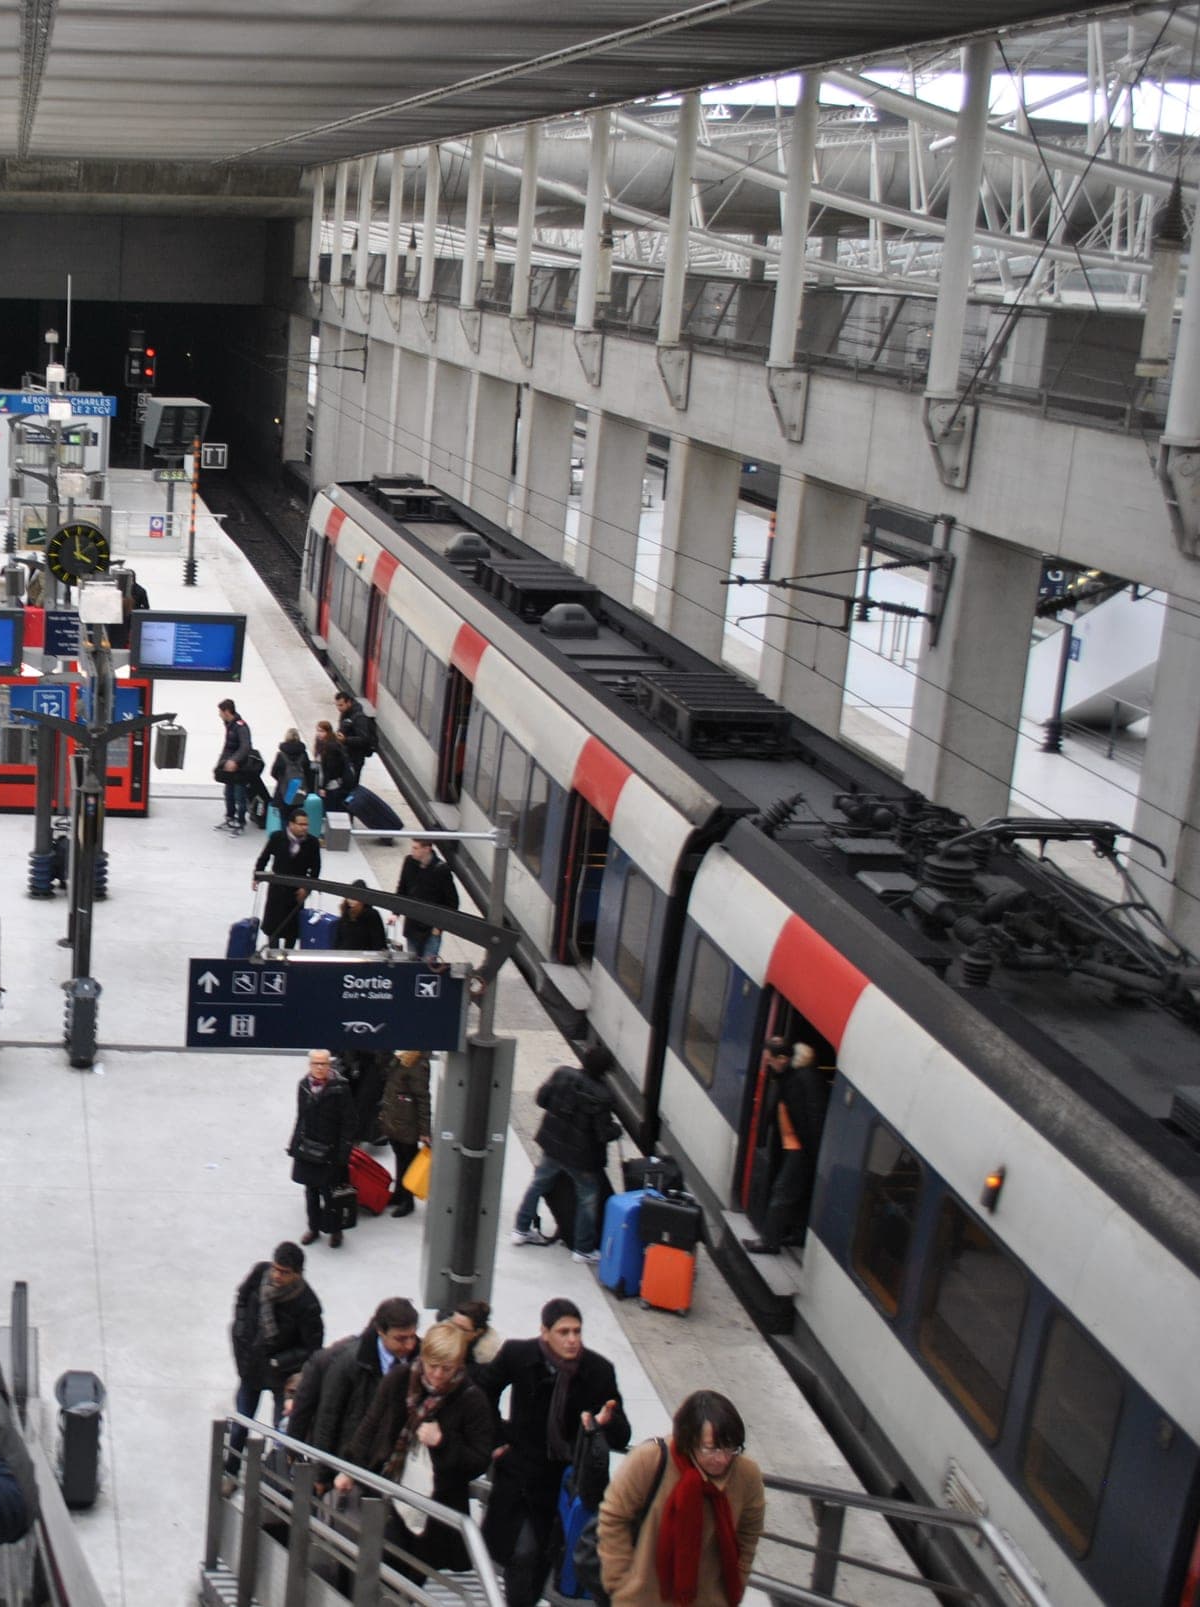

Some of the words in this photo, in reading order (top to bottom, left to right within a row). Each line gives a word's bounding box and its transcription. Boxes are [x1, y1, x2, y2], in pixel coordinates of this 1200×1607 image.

[71, 397, 111, 407] CHARLES
[33, 404, 46, 412] DE
[92, 407, 111, 415] TGV
[40, 702, 60, 717] 12
[343, 974, 393, 989] Sortie
